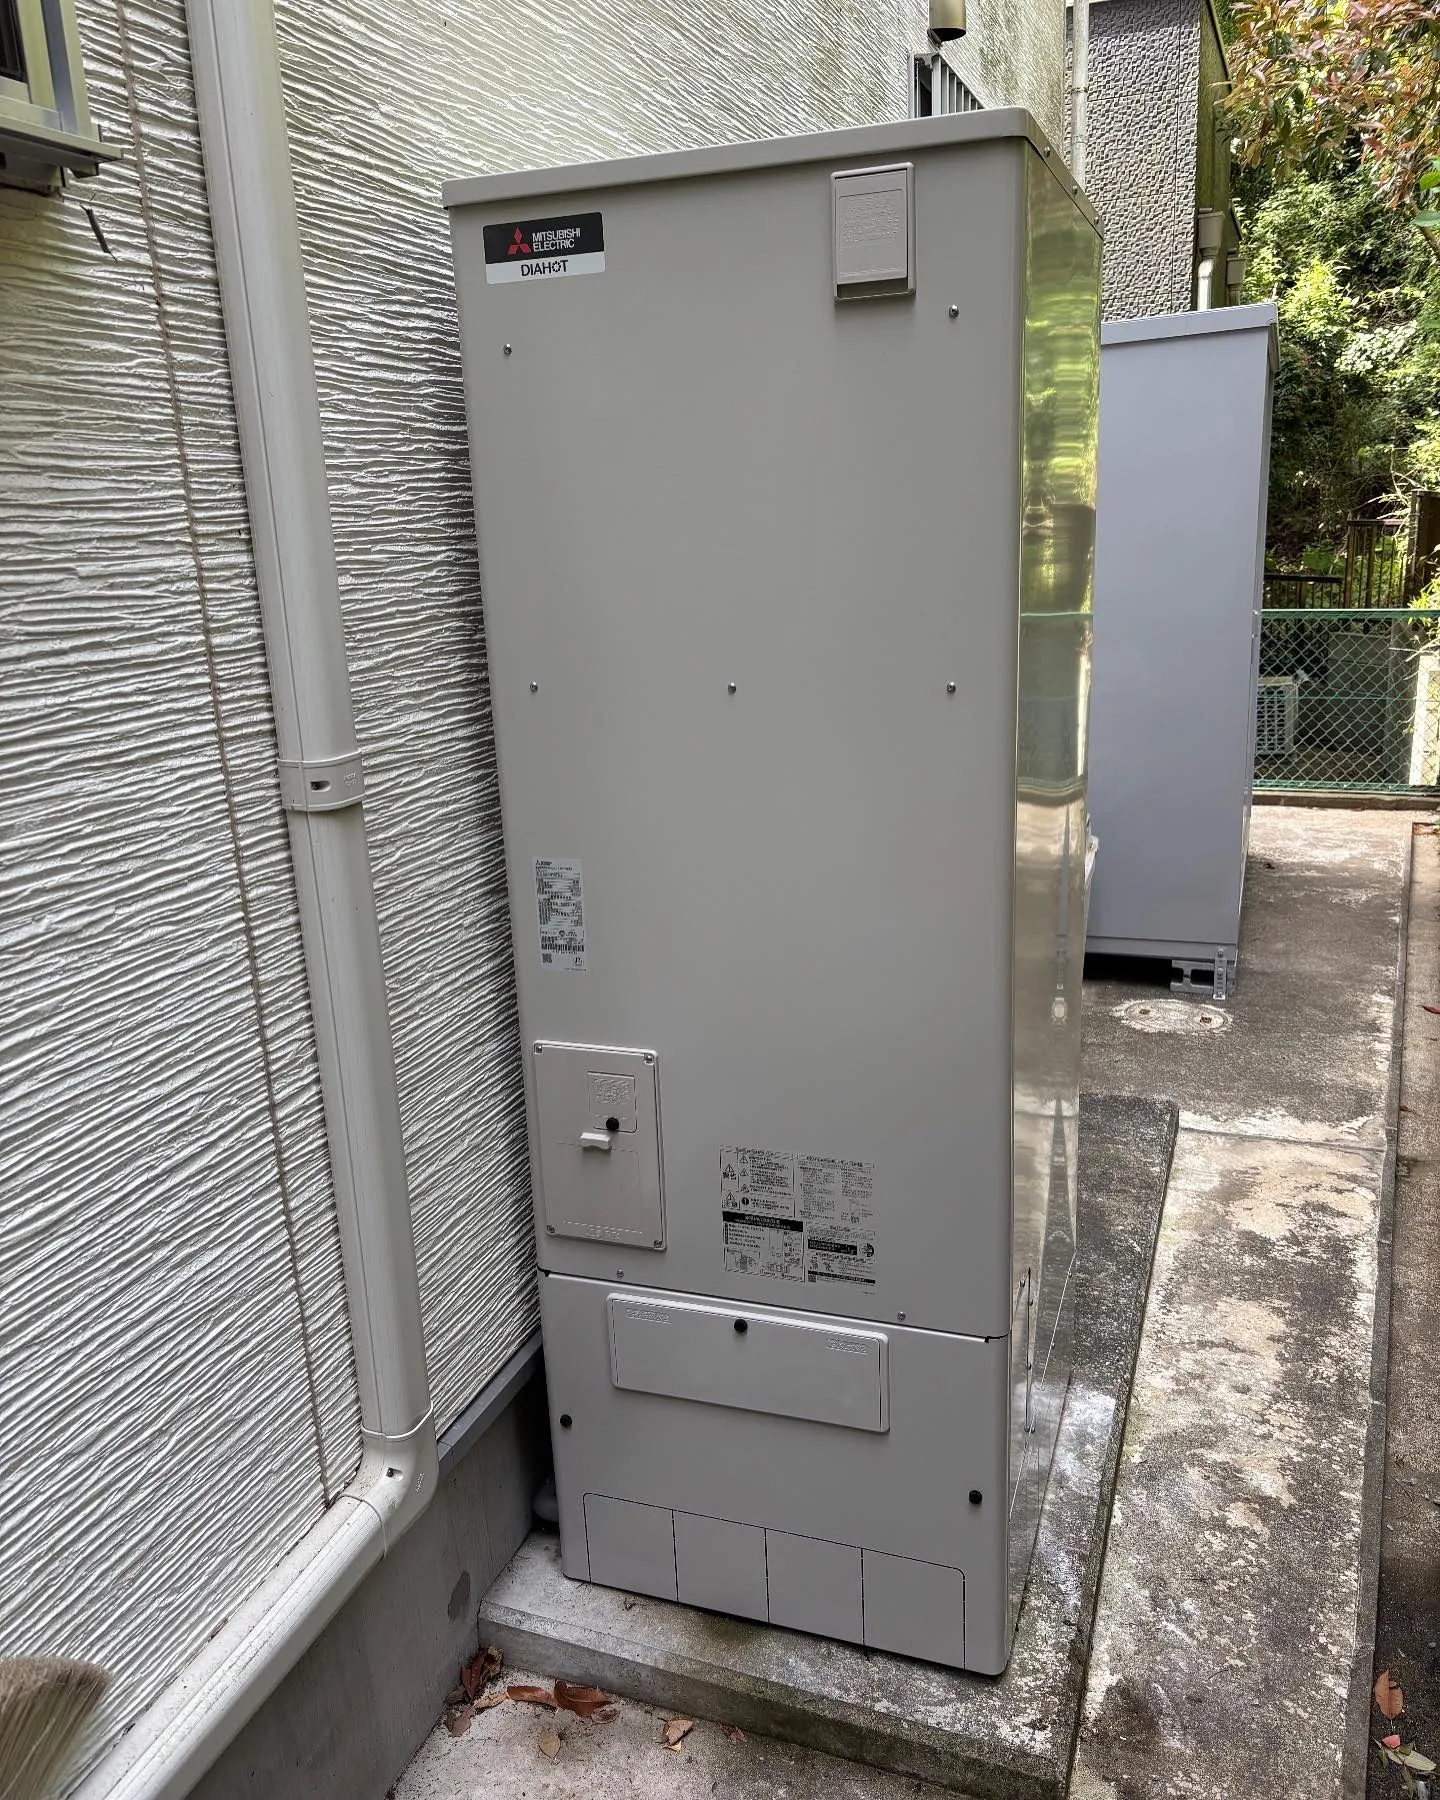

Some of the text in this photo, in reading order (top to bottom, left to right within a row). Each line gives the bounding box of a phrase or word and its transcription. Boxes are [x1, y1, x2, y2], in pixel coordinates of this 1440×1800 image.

[532, 228, 581, 242] MITSUBISHI
[533, 239, 575, 252] ELECTRIC
[521, 260, 568, 276] DIAHOT
